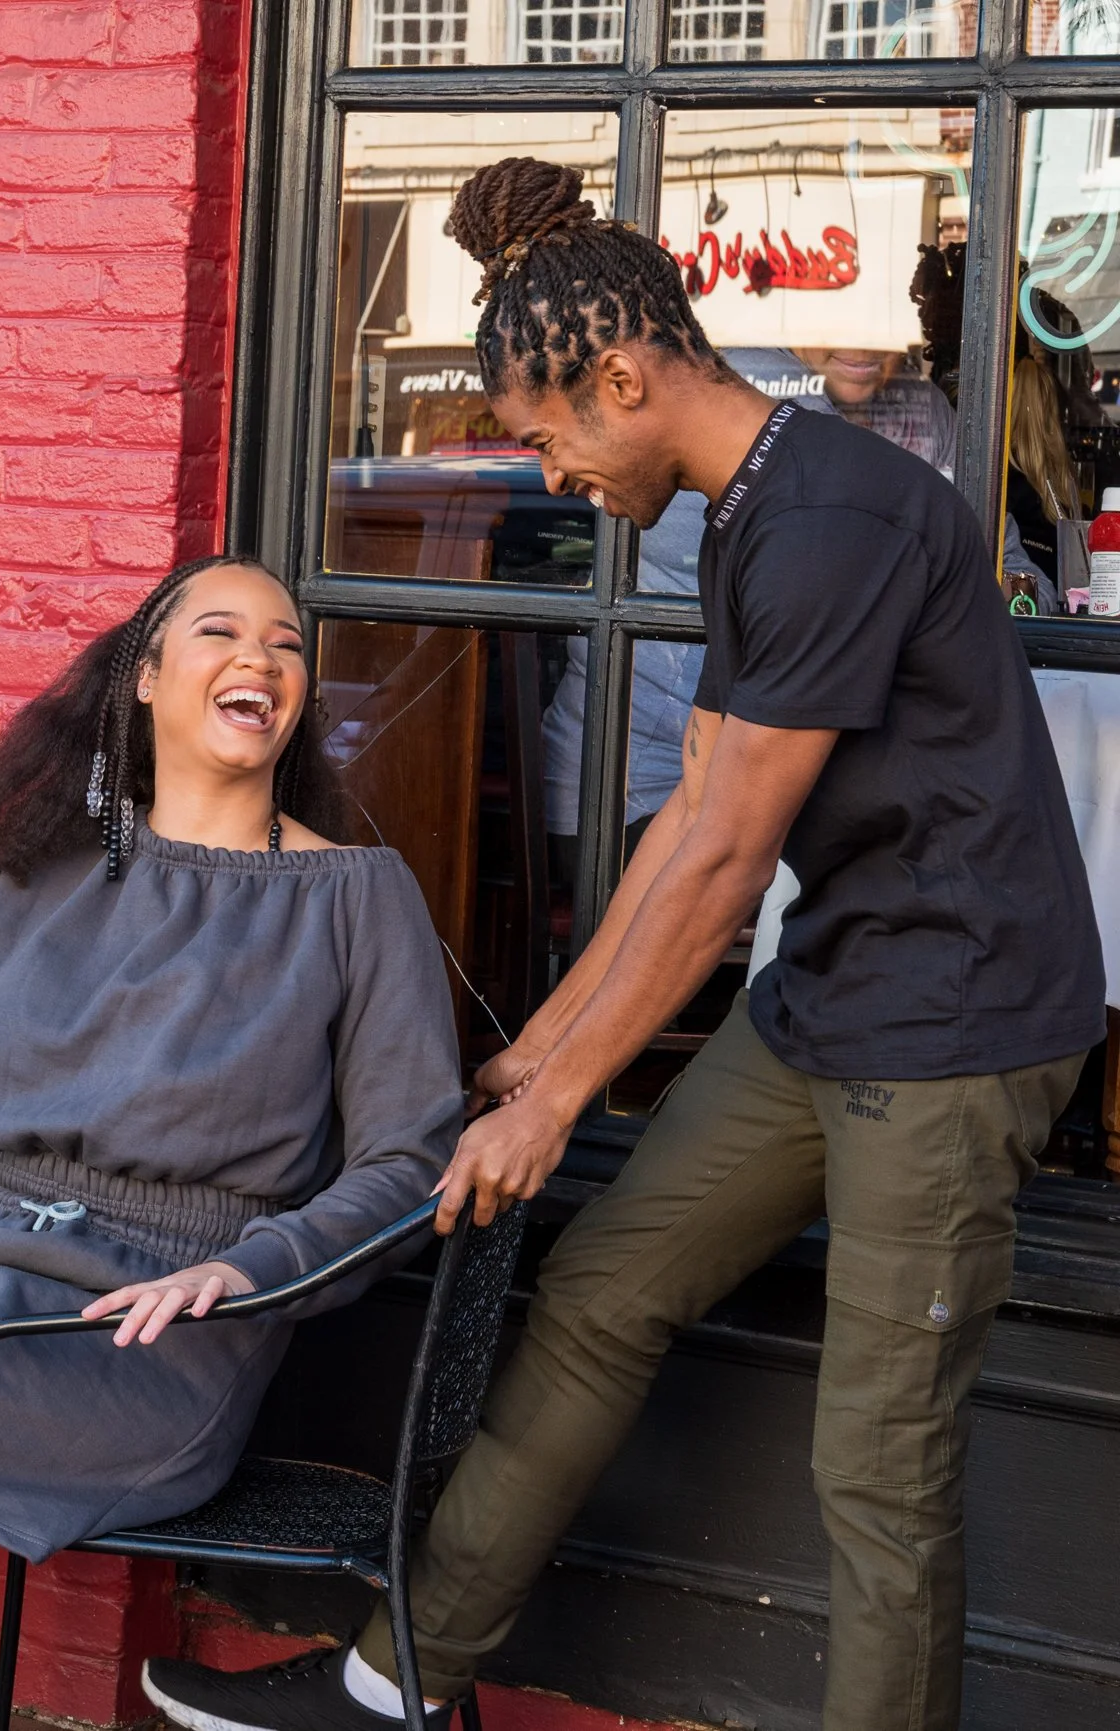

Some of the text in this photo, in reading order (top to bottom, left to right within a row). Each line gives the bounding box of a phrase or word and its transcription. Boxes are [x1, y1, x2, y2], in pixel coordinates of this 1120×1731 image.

[537, 531, 594, 545] UNDER ARMOU
[1022, 538, 1053, 553] ARMOUR
[1093, 602, 1109, 612] HEINZ
[841, 1079, 896, 1106] eighty
